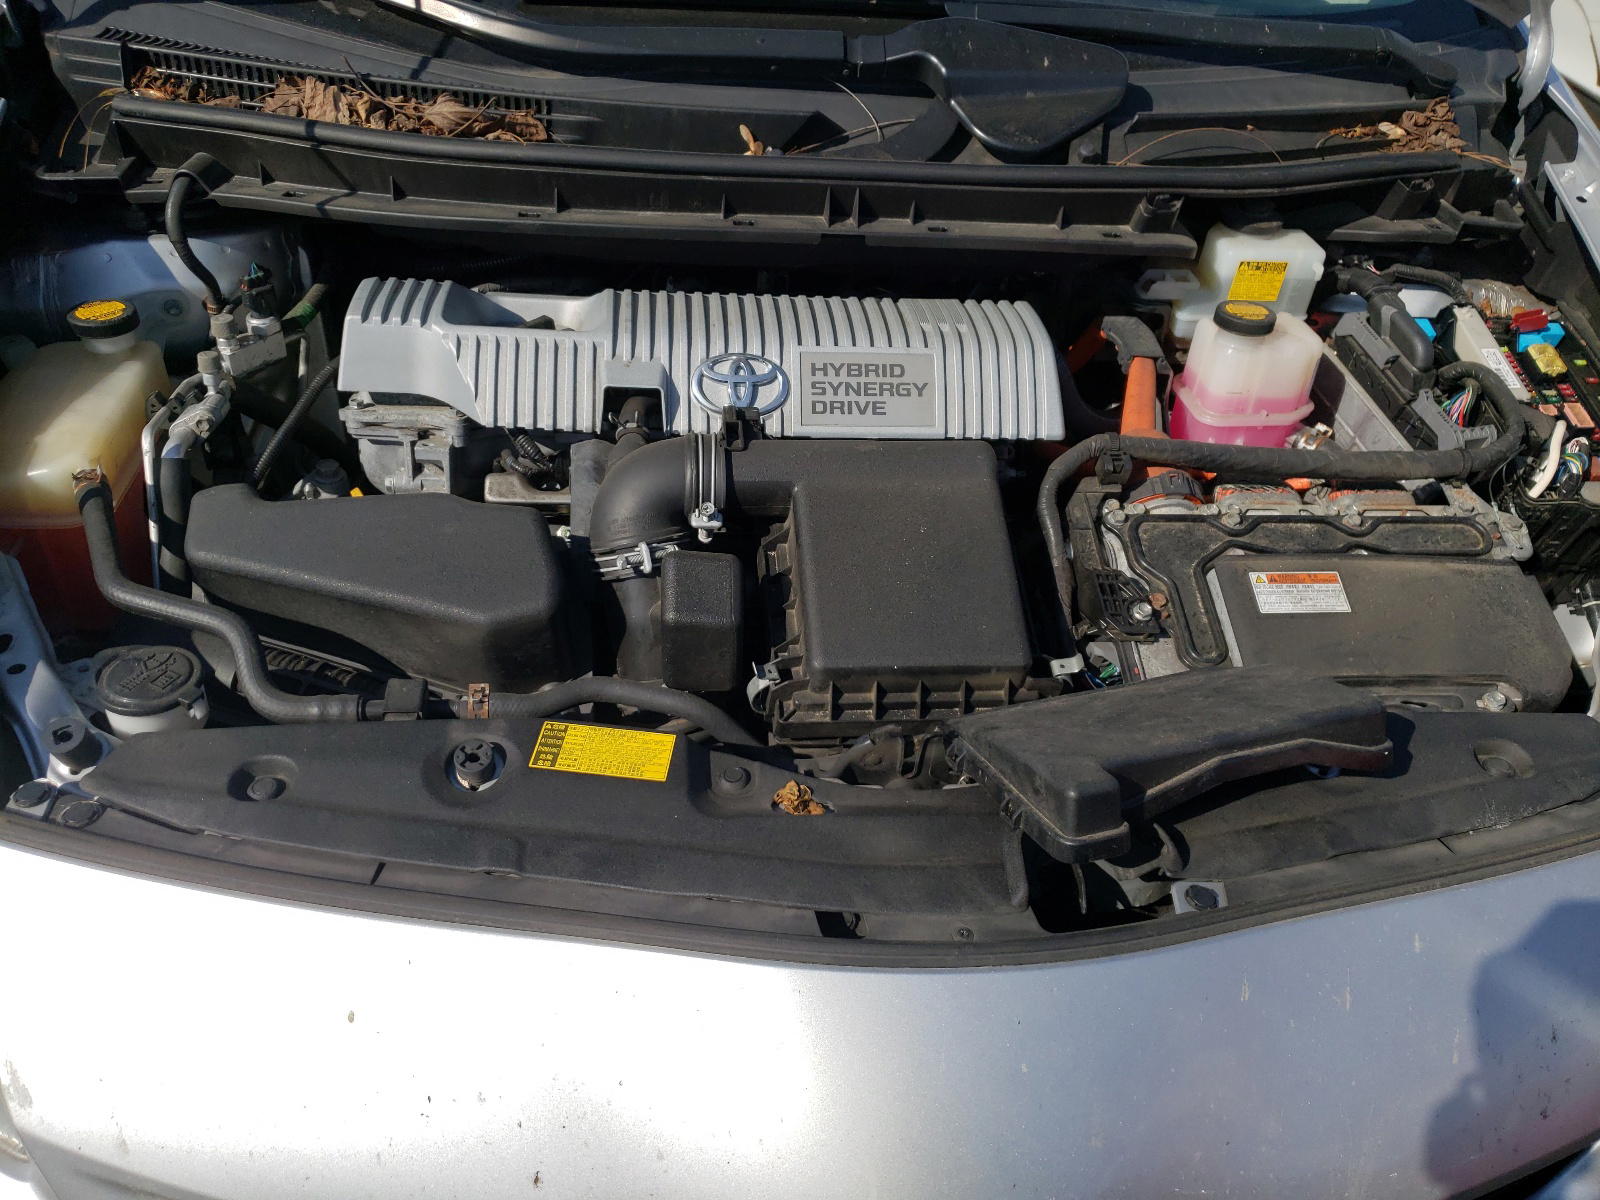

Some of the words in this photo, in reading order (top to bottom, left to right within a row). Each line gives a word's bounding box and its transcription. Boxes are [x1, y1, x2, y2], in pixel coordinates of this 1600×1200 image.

[811, 362, 906, 378] HYBRID
[811, 381, 929, 398] SYNERGY
[811, 400, 887, 416] DRIVE
